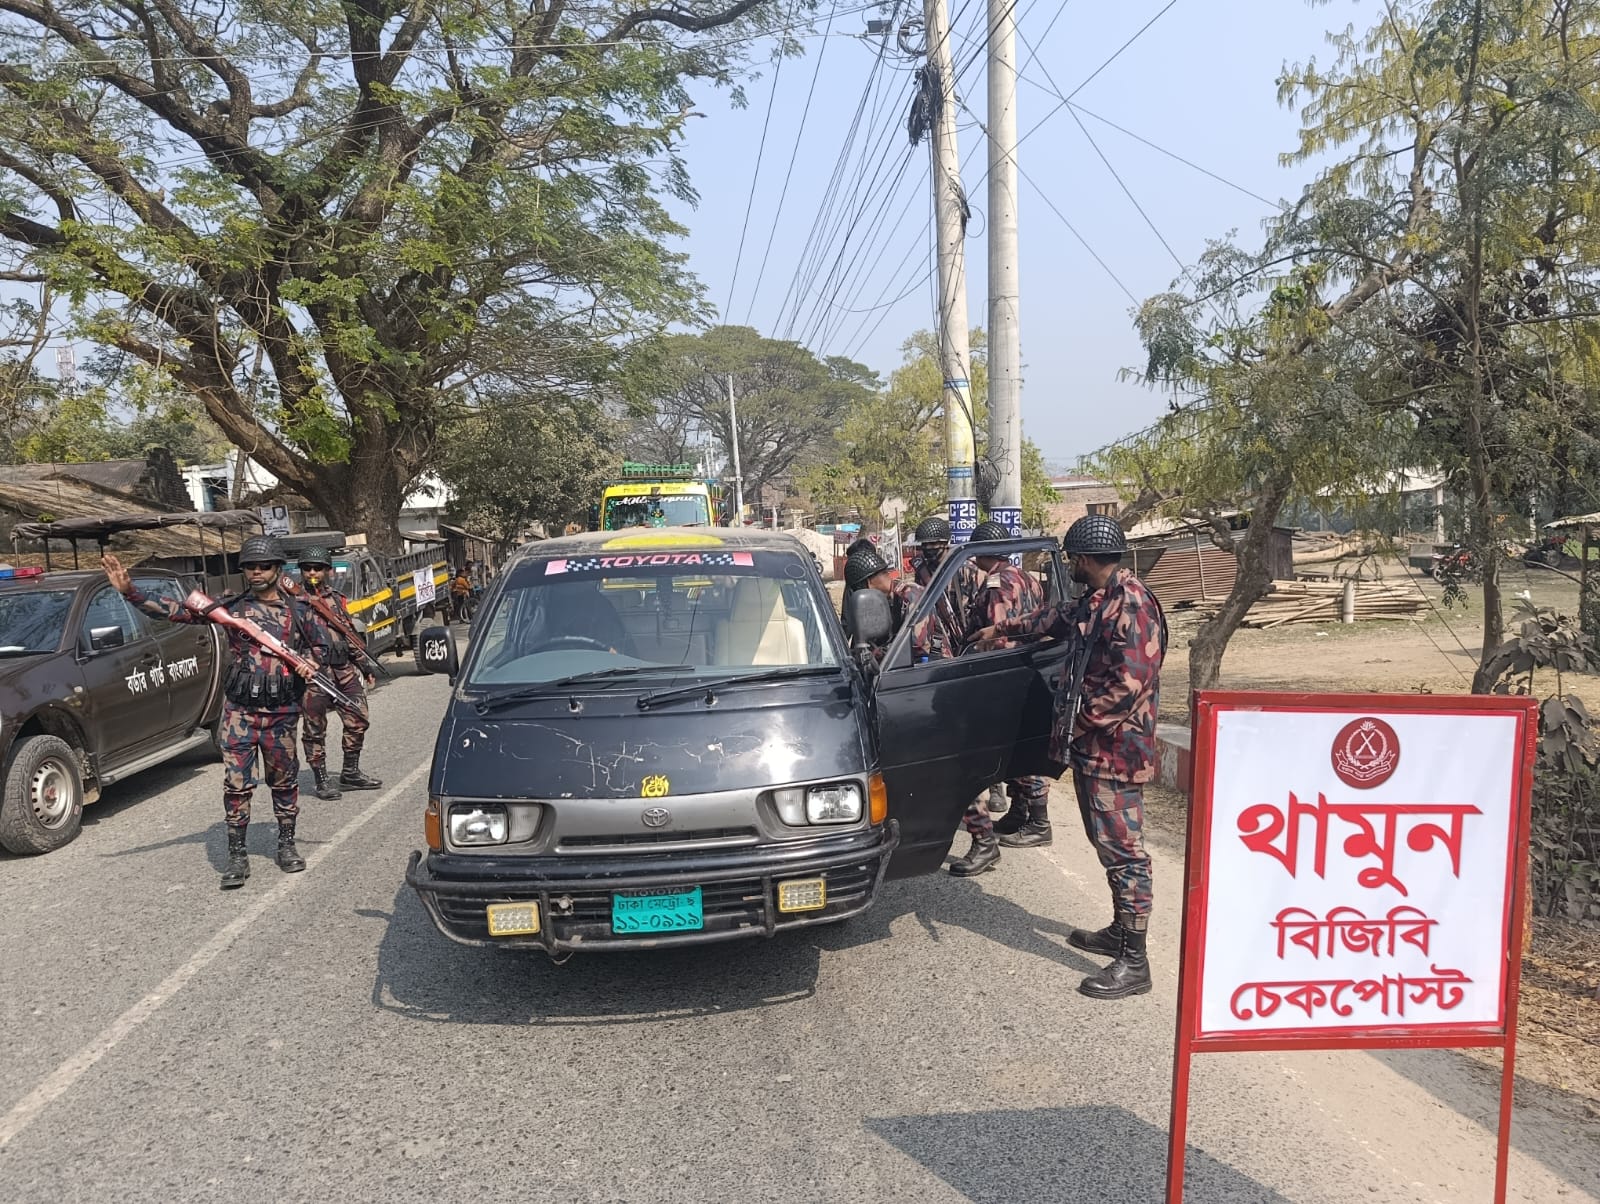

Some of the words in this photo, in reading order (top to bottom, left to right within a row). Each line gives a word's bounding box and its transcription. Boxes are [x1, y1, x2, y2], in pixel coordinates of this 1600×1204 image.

[599, 554, 702, 568] TOYOTA
[125, 666, 148, 696] বর্ডার
[149, 659, 165, 688] গার্ড
[166, 655, 199, 682] বাংলাদেশ
[1237, 790, 1484, 897] থামুন
[615, 912, 700, 930] ১১-০৯১৯
[618, 898, 643, 911] ঢাকা
[1269, 905, 1439, 960] বিজিবি
[1230, 964, 1473, 1021] চেকপোস্ট
